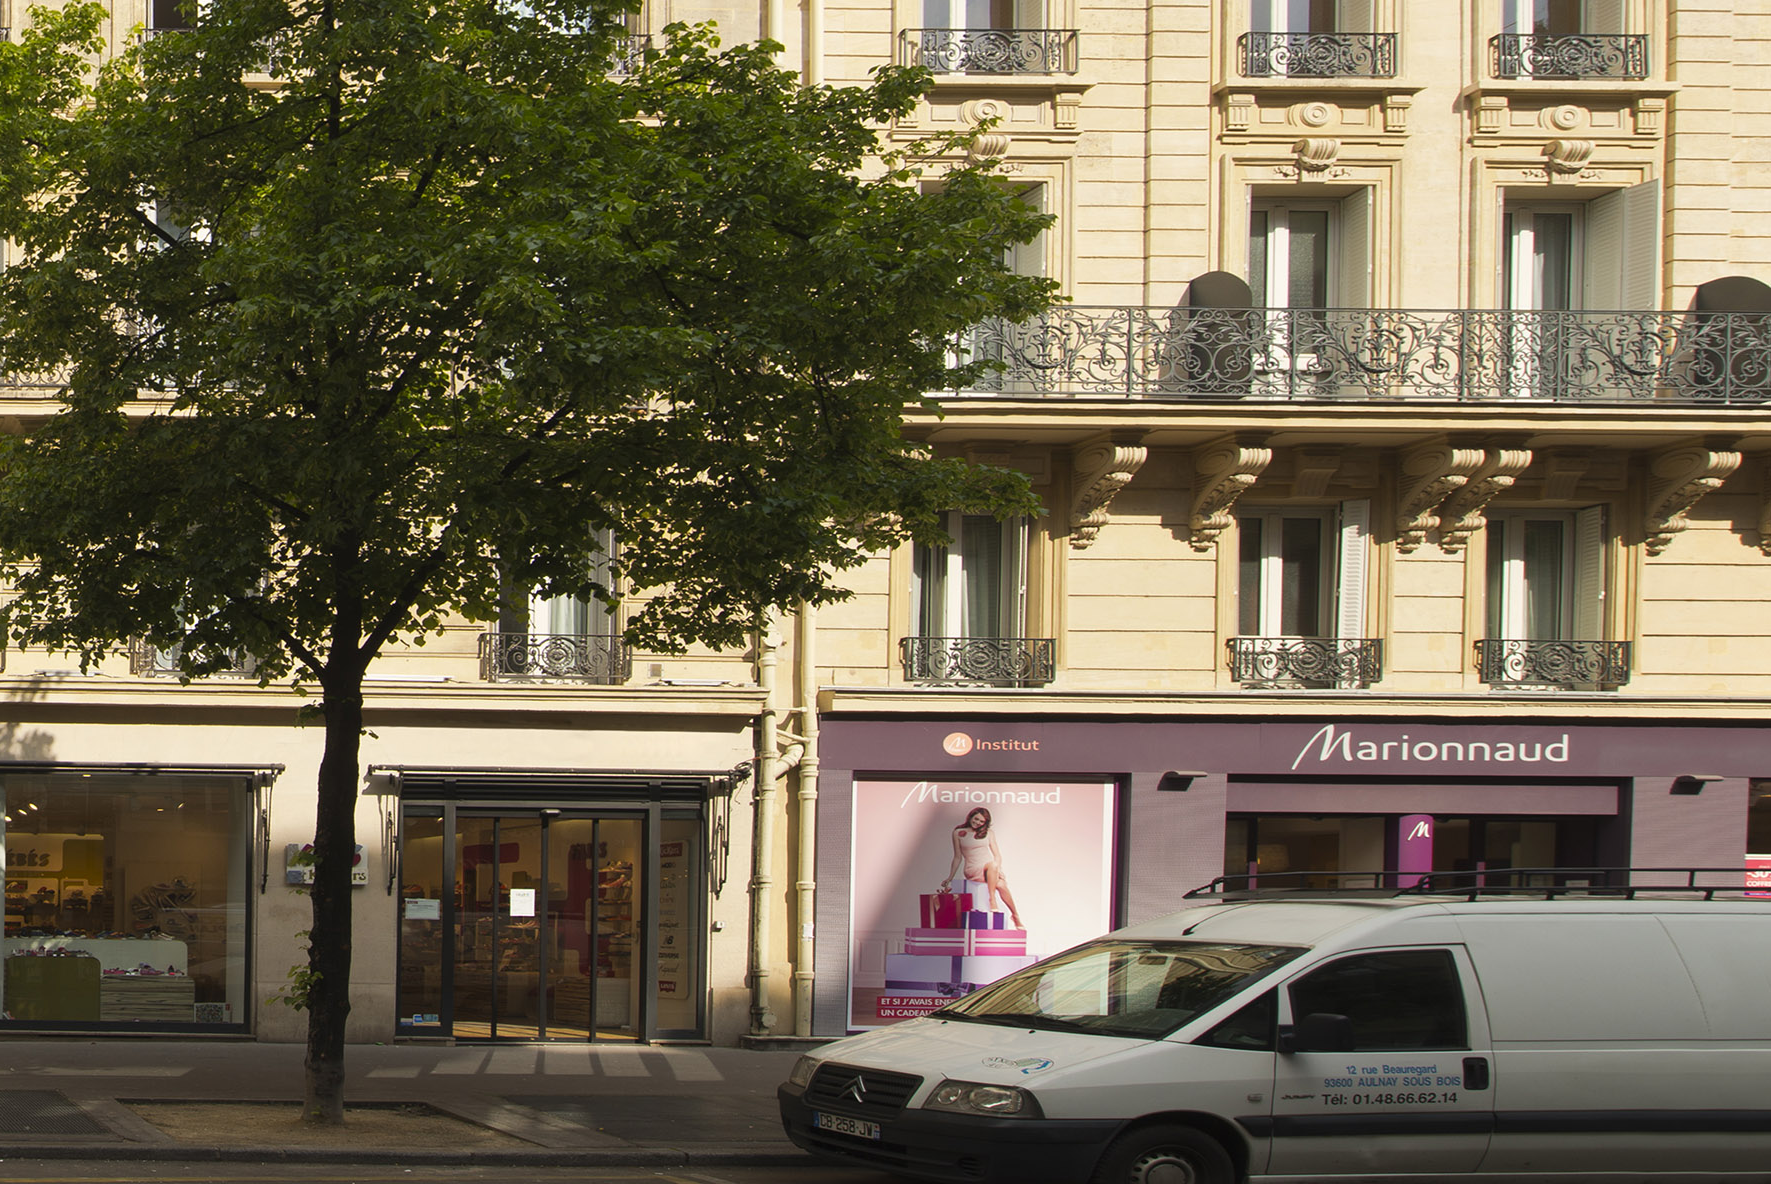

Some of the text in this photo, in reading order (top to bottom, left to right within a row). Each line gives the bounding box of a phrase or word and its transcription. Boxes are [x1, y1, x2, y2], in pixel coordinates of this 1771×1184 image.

[976, 739, 1040, 751] Institut
[1291, 723, 1570, 770] Marionnaud
[900, 781, 1061, 809] Marionnaud
[1345, 1066, 1357, 1074] 12
[1383, 1065, 1437, 1076] Beauregard
[1324, 1076, 1461, 1088] 93600 AULNAY SOUS BOIS
[1322, 1092, 1458, 1105] Tél: 01.48.66.62.14
